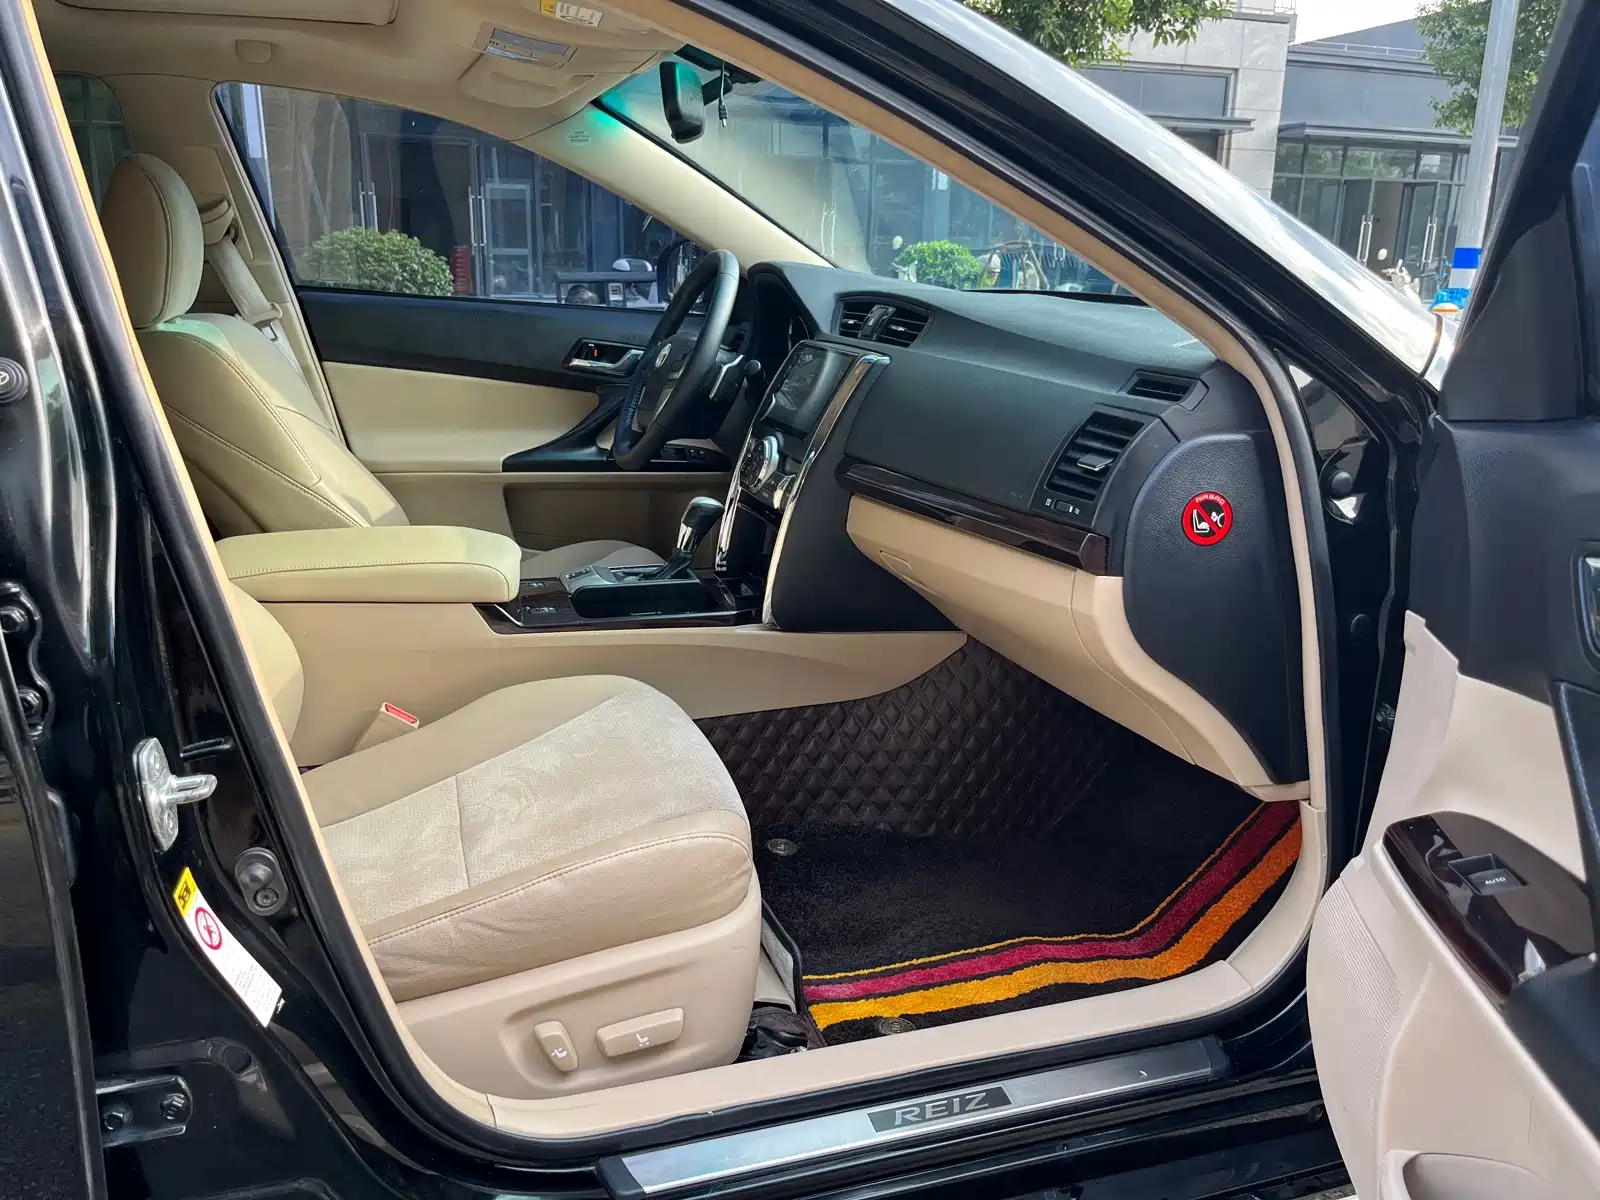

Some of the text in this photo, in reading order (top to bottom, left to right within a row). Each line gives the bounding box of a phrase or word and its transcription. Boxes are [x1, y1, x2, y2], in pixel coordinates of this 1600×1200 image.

[1195, 494, 1226, 505] AIRBAG
[1485, 877, 1506, 885] AUTO
[894, 1092, 989, 1126] REIZ
